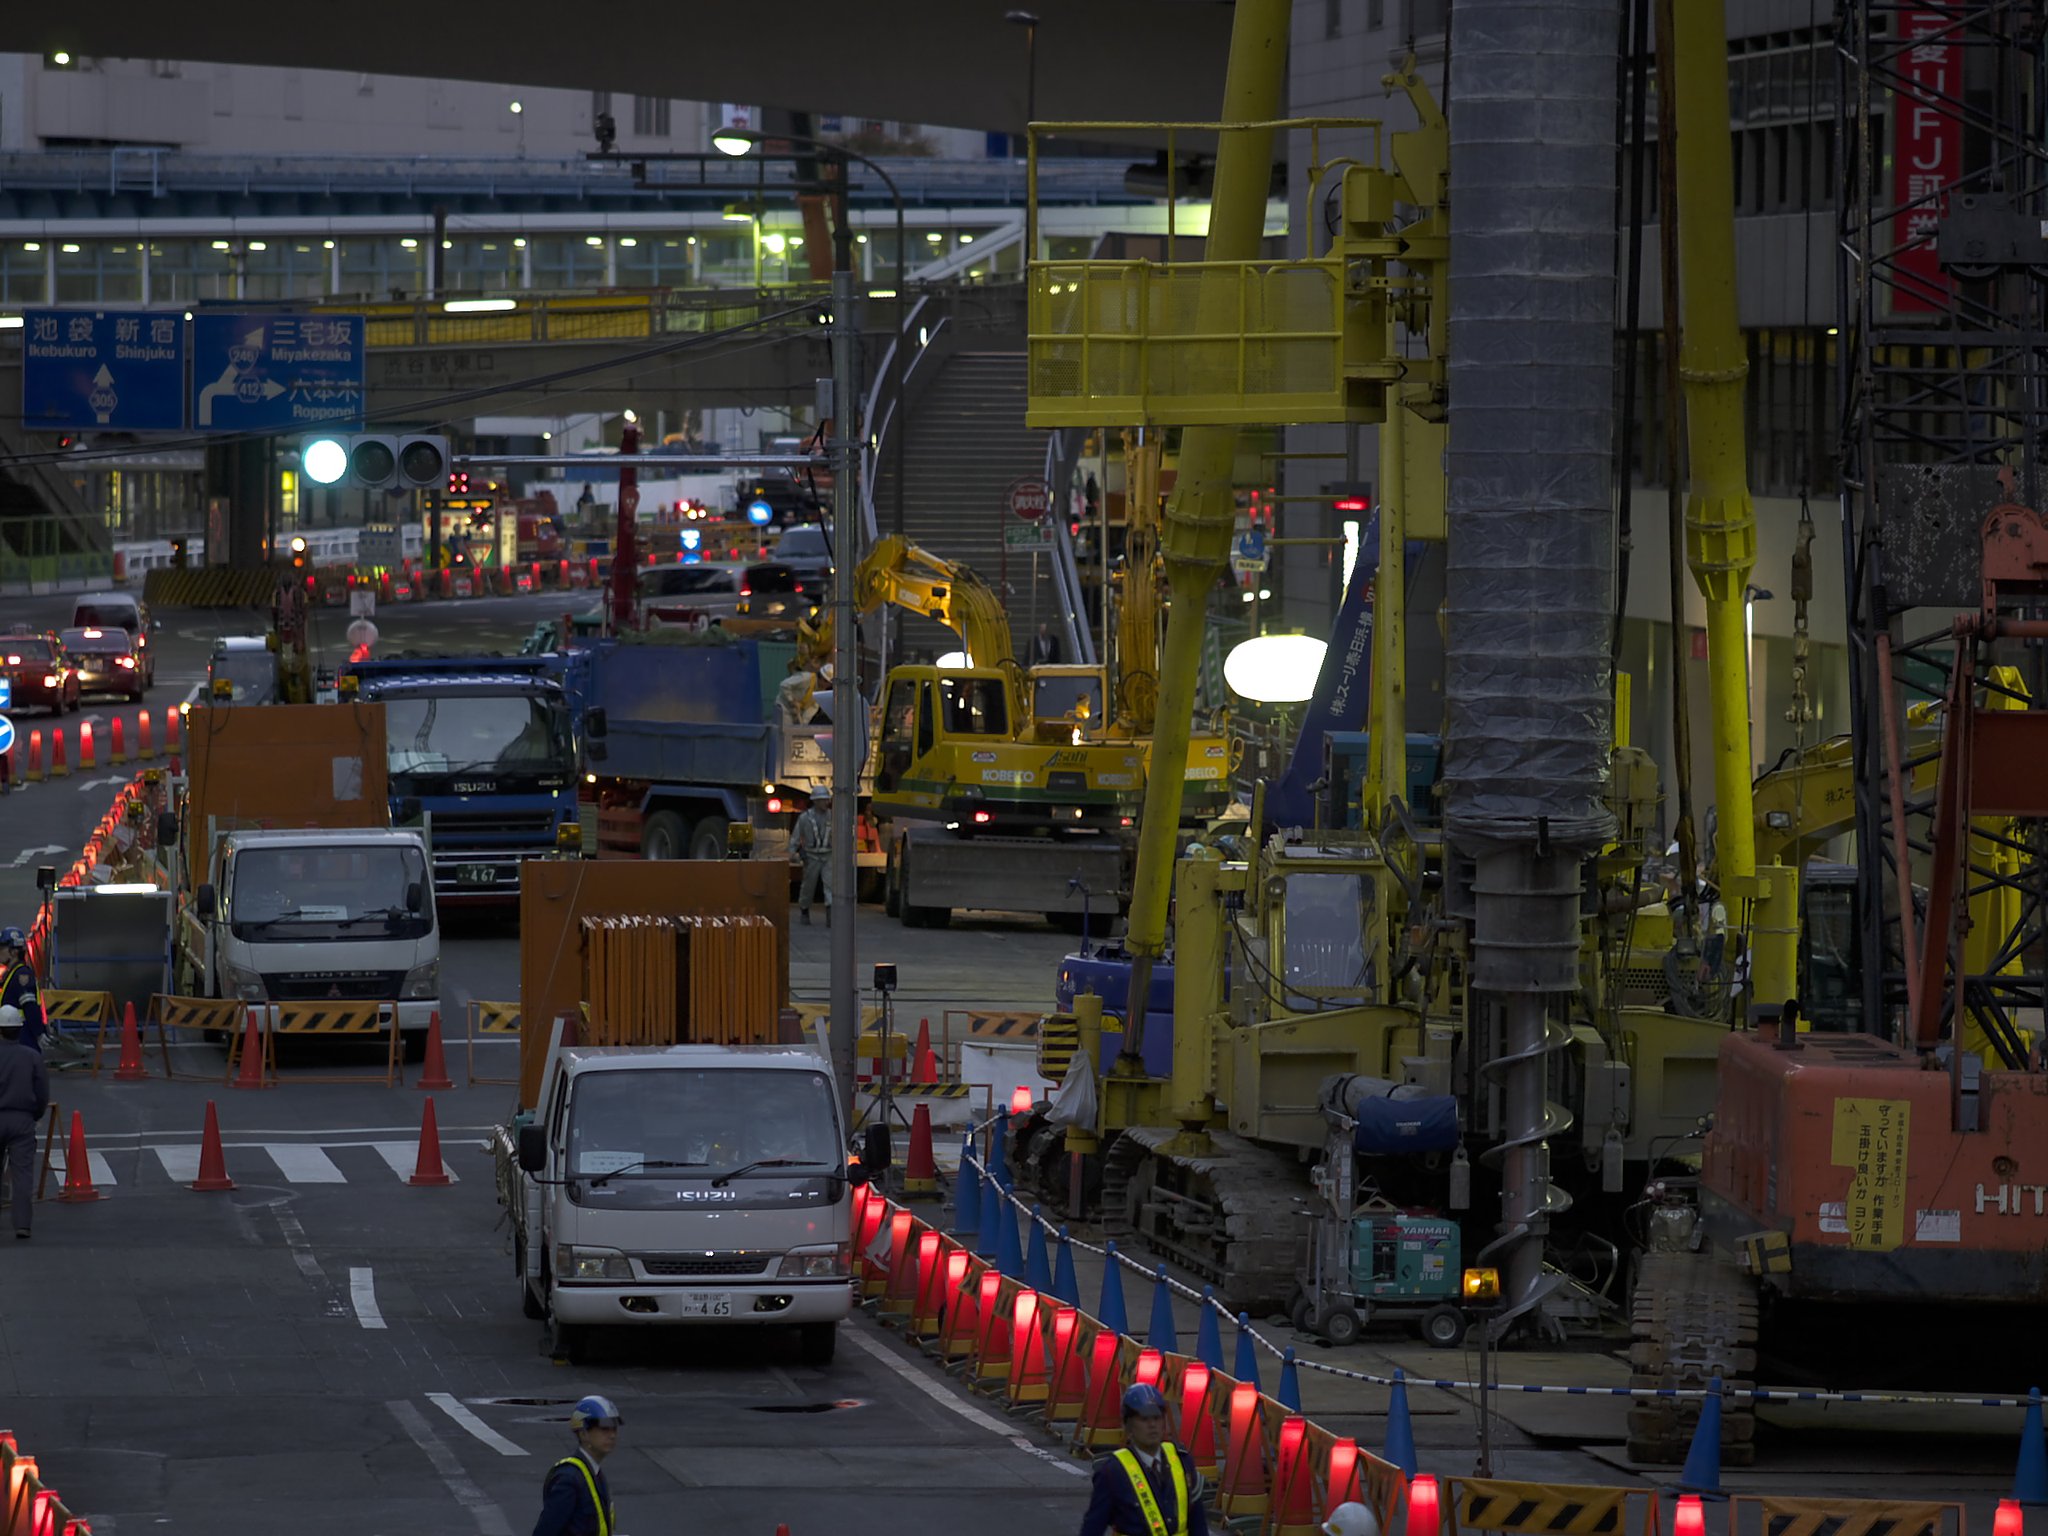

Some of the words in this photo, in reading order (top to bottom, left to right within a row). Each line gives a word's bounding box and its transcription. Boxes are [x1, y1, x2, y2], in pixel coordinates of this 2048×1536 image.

[33, 317, 93, 342] 池袋
[115, 318, 175, 343] 新宿
[271, 321, 352, 345] 三宅坂
[28, 344, 97, 358] Ikebukuro
[116, 344, 175, 361] Shinjuku
[232, 350, 256, 362] 246
[271, 348, 352, 363] Miyakezaka
[239, 382, 259, 396] 412
[288, 378, 359, 402] 六本木
[92, 394, 114, 407] 305
[292, 404, 356, 421] Roppongi
[453, 782, 497, 792] ISUZU
[676, 1190, 736, 1202] ISUZU
[1870, 1194, 1885, 1246] 作業手順
[1402, 1226, 1451, 1235] YANMAR
